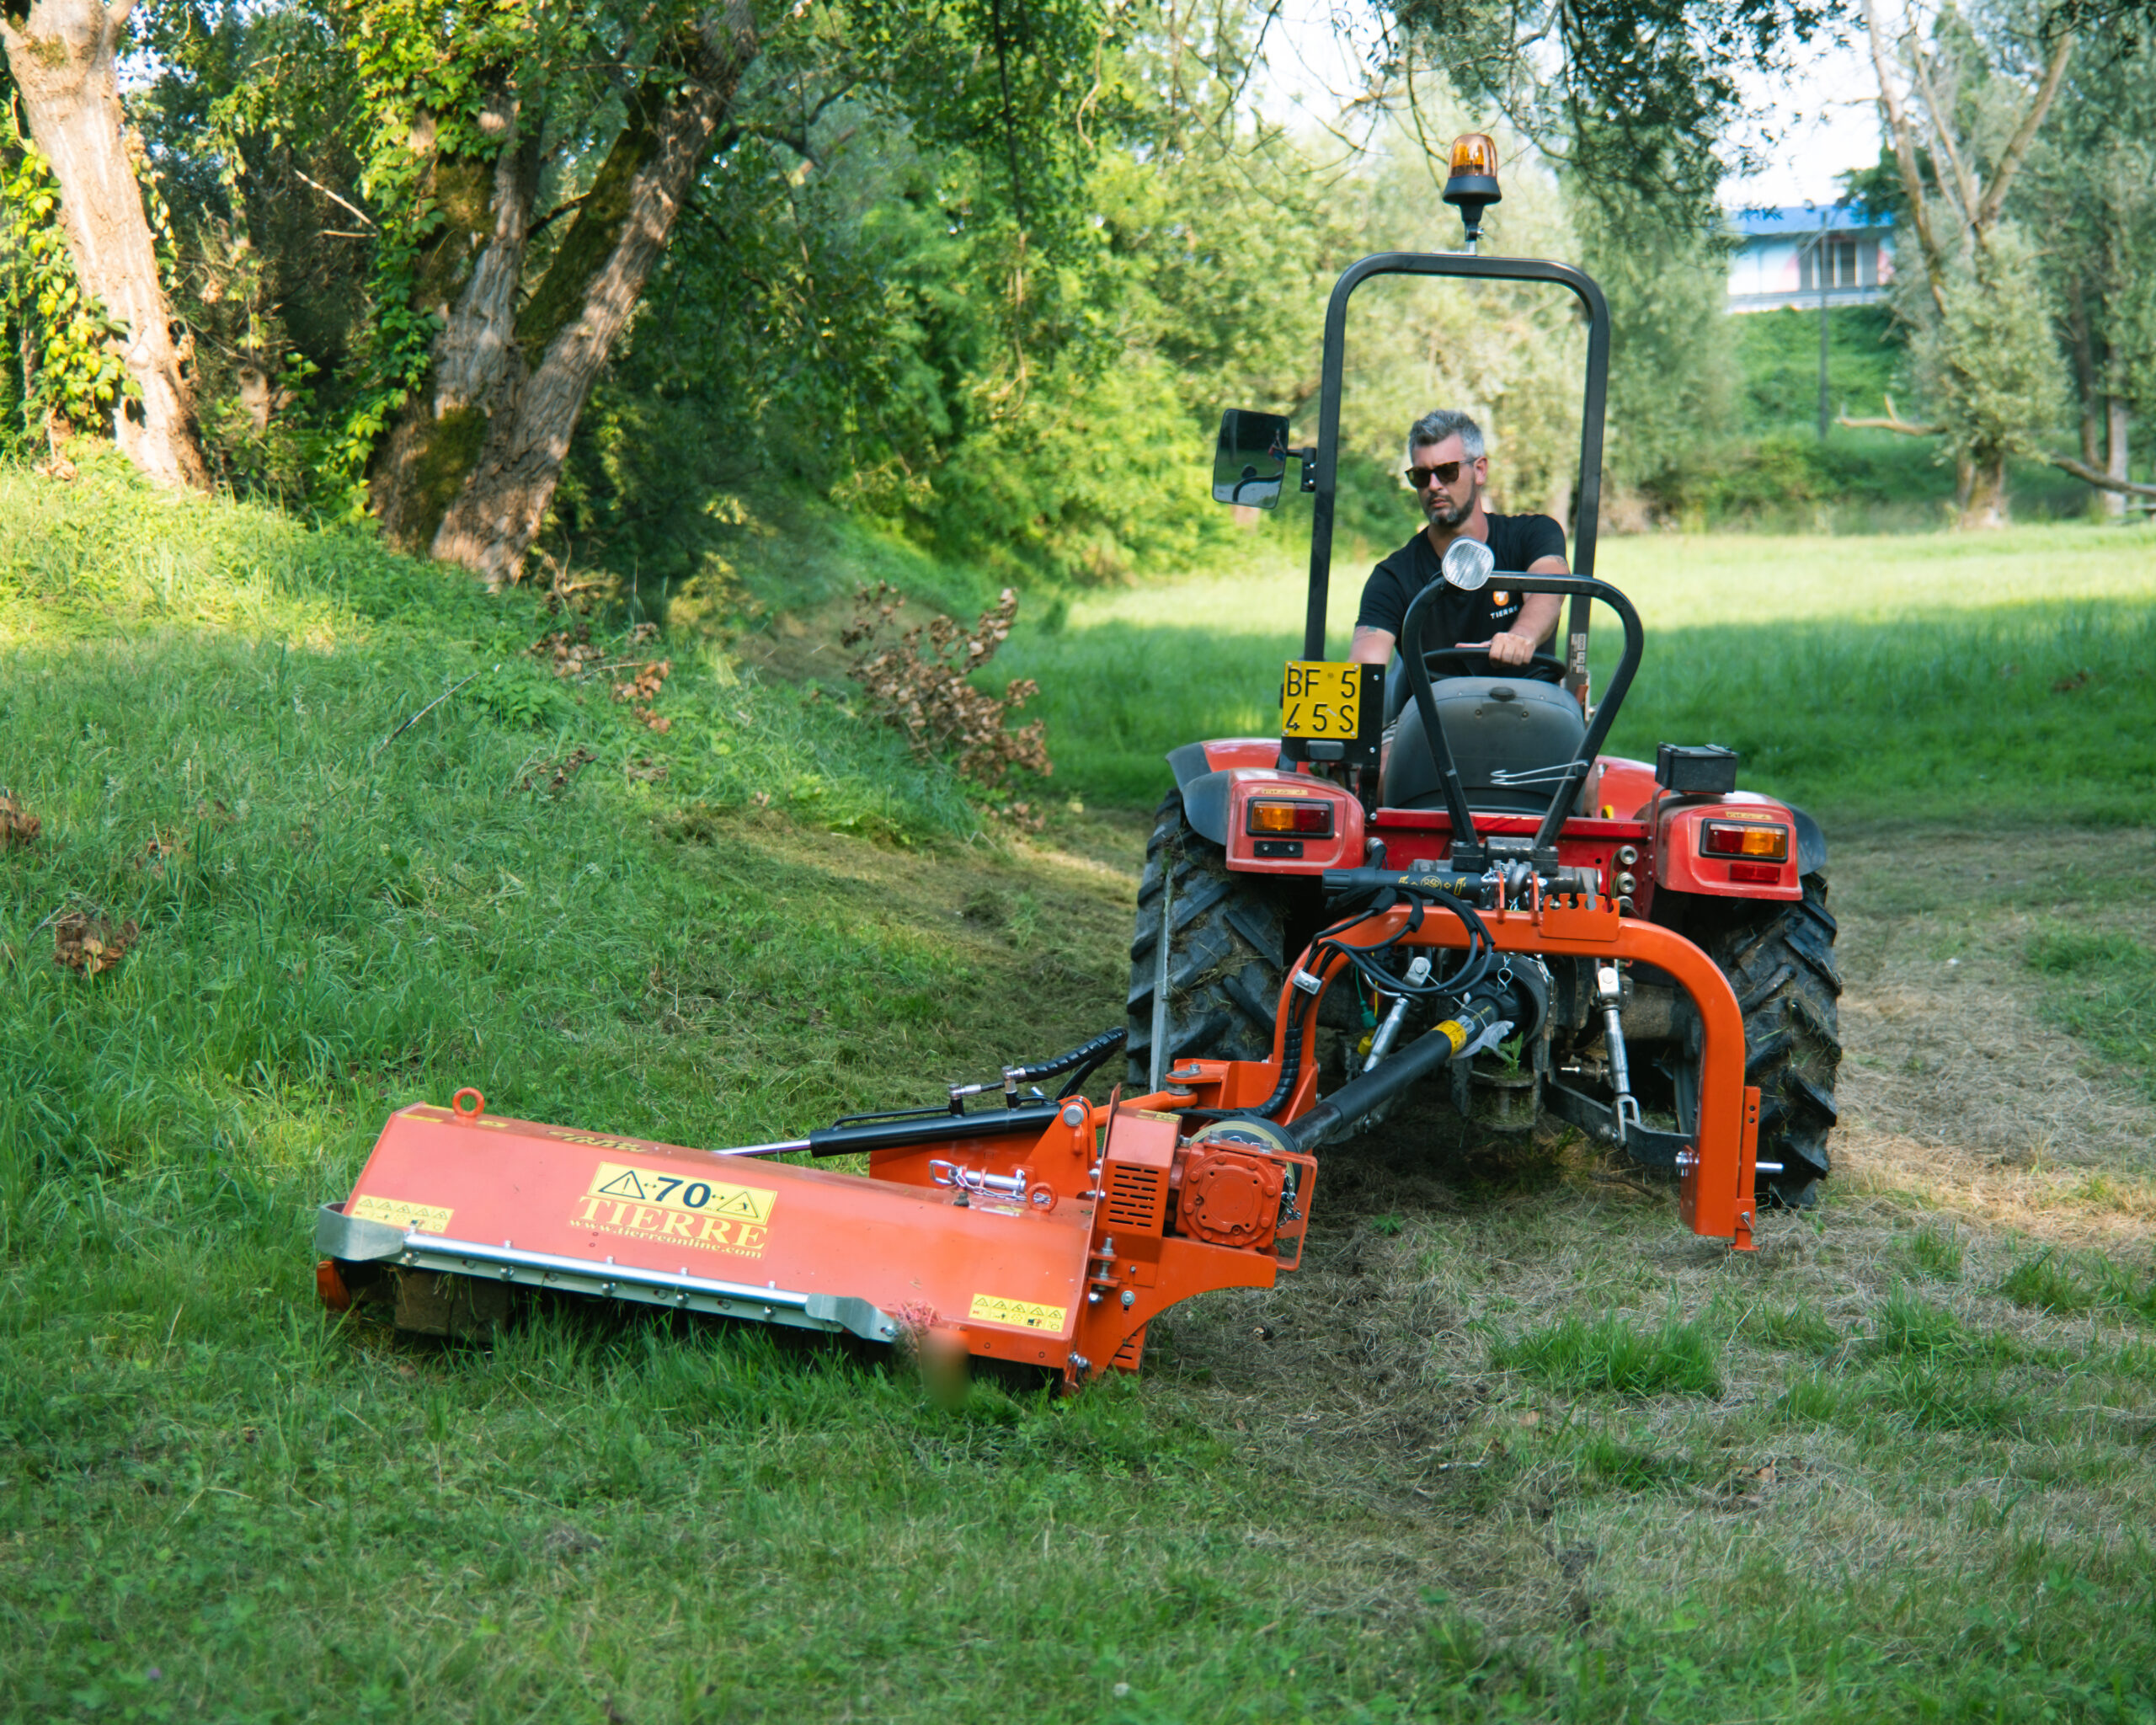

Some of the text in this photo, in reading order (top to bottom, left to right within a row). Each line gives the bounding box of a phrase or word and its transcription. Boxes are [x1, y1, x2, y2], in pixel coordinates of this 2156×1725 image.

[1286, 667, 1357, 698] BF 5
[654, 1176, 712, 1209] 70
[569, 1219, 762, 1259] www.tierreonline.com
[579, 1195, 768, 1250] TIERRE
